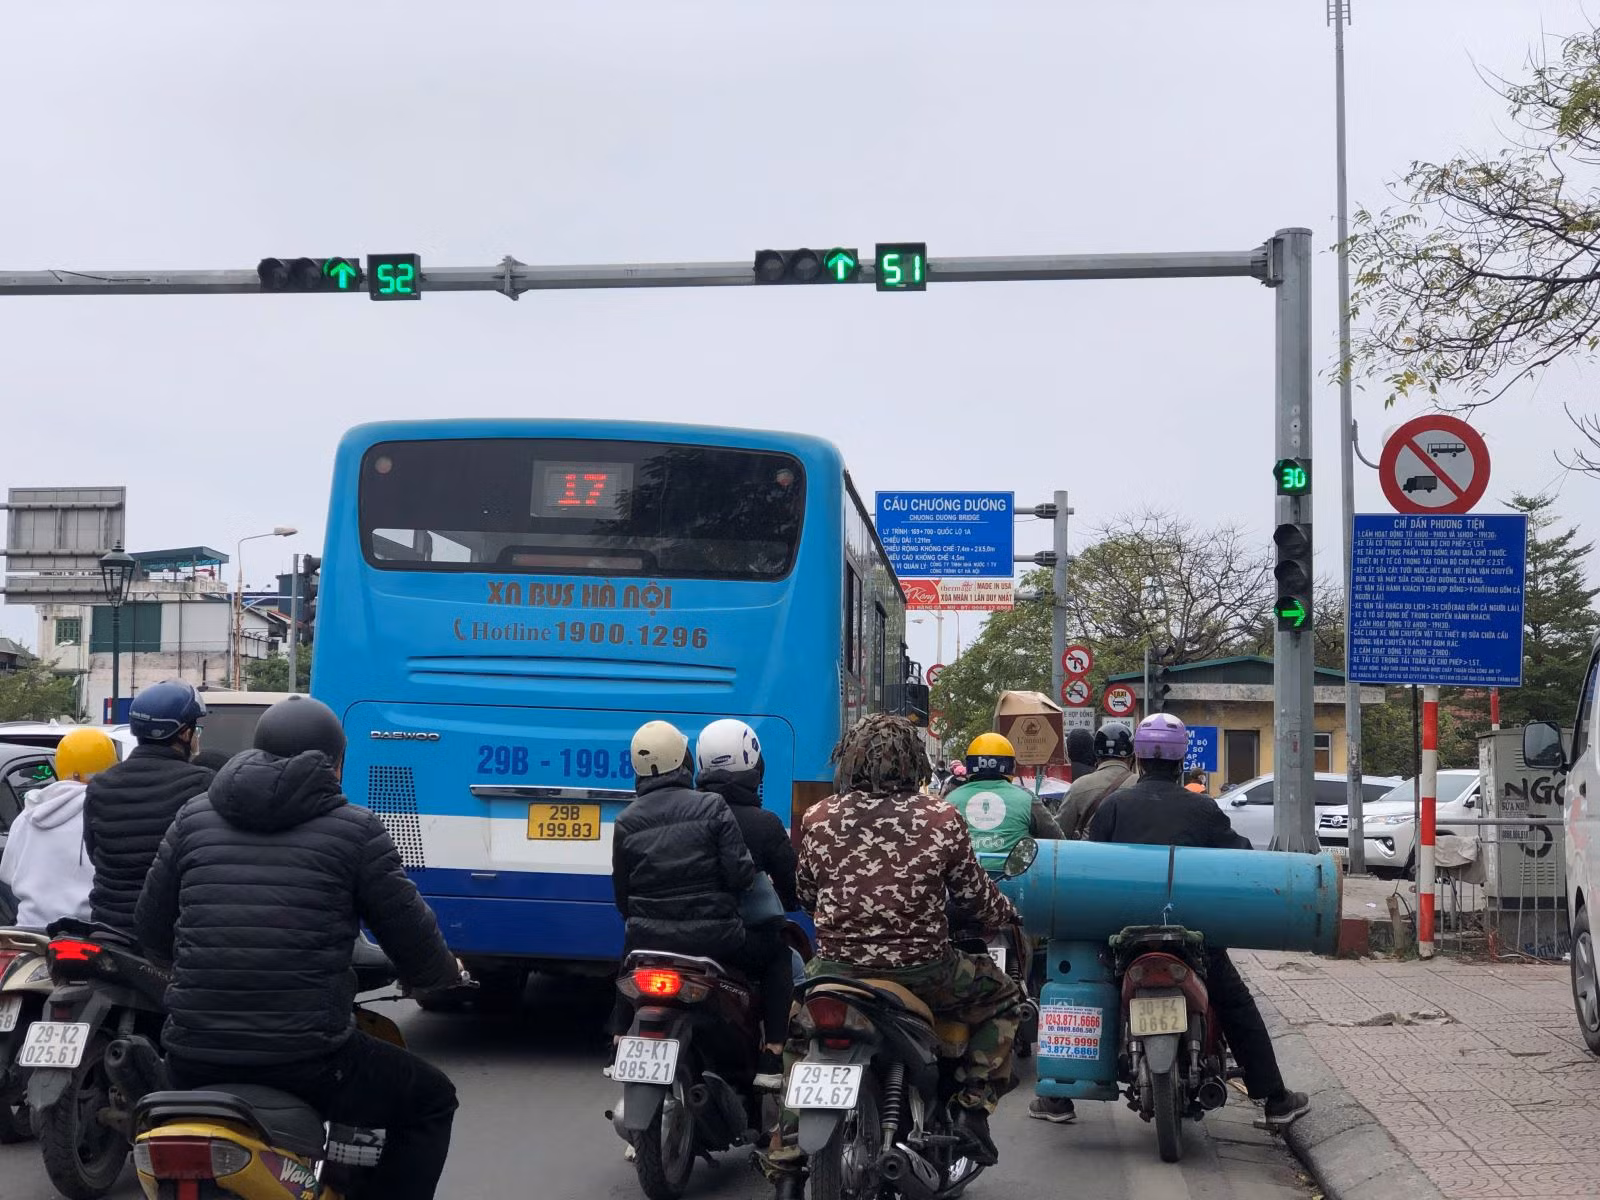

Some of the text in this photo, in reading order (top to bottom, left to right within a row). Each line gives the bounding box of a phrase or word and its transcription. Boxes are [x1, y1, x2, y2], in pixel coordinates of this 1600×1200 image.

[377, 263, 414, 293] 52
[883, 253, 921, 284] 51
[1283, 467, 1306, 488] 30
[558, 473, 607, 505] 17
[976, 582, 992, 590] MADE
[993, 582, 1000, 590] IN
[1000, 582, 1012, 590] USA
[529, 583, 574, 607] BUS
[582, 580, 616, 608] HÀ
[622, 581, 672, 616] NỘI
[472, 621, 708, 649] Hotline 1900.1296
[370, 730, 441, 742] DAEWOO
[477, 744, 529, 776] 29B
[560, 747, 635, 780] 199.8
[978, 756, 997, 769] be
[549, 805, 580, 821] 29B
[537, 822, 592, 838] 199.83
[1138, 999, 1179, 1016] 30-F4
[35, 1025, 79, 1044] 29-K2
[1047, 1036, 1099, 1047] 3.875.9999
[25, 1046, 78, 1064] 025.61
[626, 1040, 669, 1060] 29-K1
[618, 1061, 671, 1082] 985.21
[801, 1066, 851, 1085] 29-E2
[794, 1086, 853, 1106] 124.67
[280, 1157, 316, 1189] Wave
